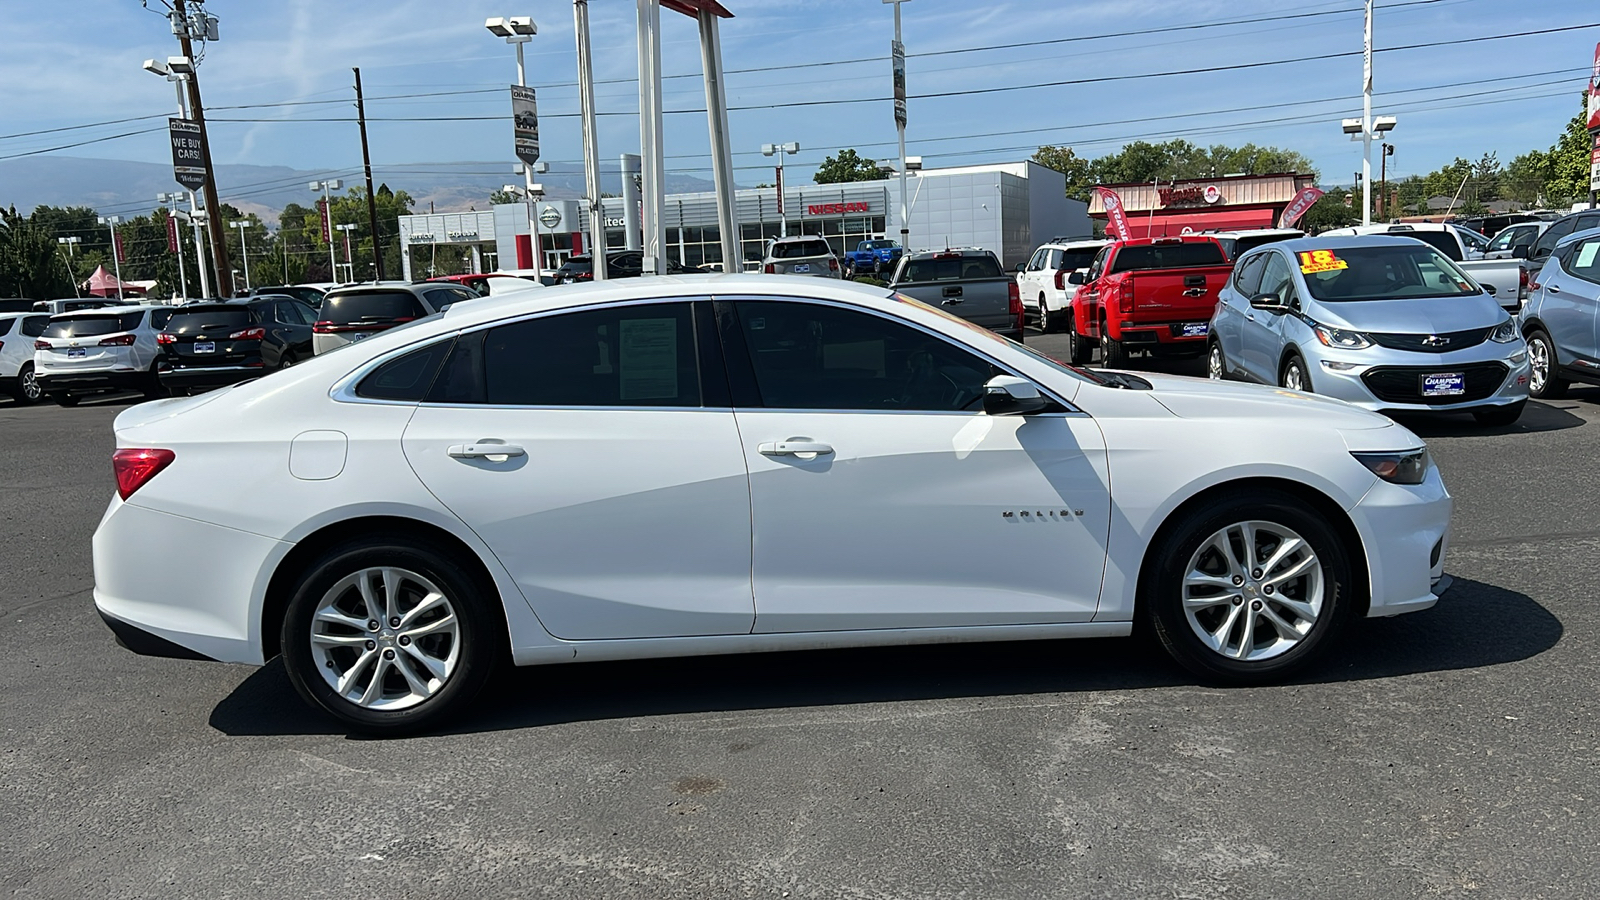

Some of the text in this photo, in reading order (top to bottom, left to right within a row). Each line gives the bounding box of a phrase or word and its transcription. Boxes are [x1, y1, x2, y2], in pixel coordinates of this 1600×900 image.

[172, 138, 201, 149] WE BUY
[178, 149, 201, 160] CARS!
[808, 202, 868, 215] NISSAN
[1301, 250, 1333, 265] 18
[1425, 377, 1461, 385] CHAMPION
[1002, 508, 1084, 517] MALIBU
